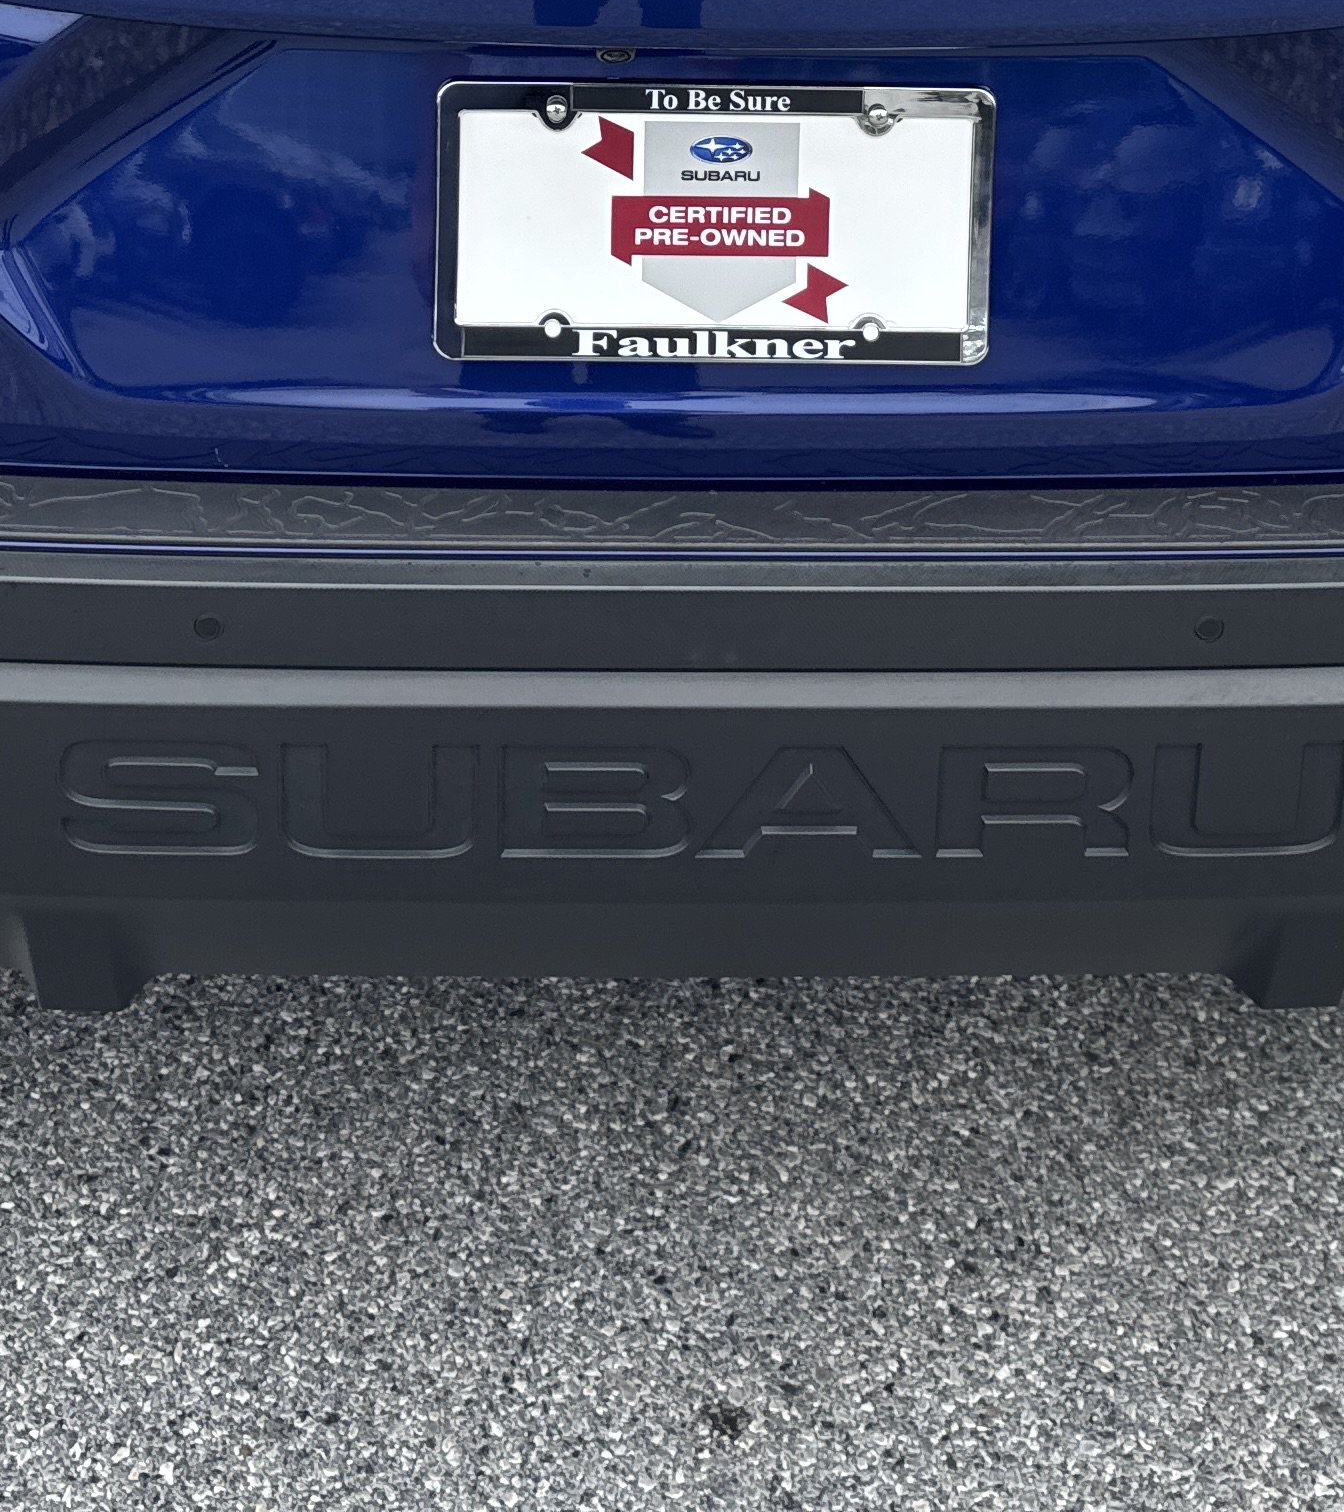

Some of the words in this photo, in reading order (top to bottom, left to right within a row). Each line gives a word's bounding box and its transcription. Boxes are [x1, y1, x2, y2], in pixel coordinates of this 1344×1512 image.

[645, 88, 679, 110] To
[687, 89, 722, 110] Be
[729, 90, 791, 112] Sure
[680, 170, 761, 181] SUBARU
[648, 206, 792, 225] CERTIFIED
[634, 228, 806, 247] PRE-OWNED
[571, 329, 856, 360] Faulkner
